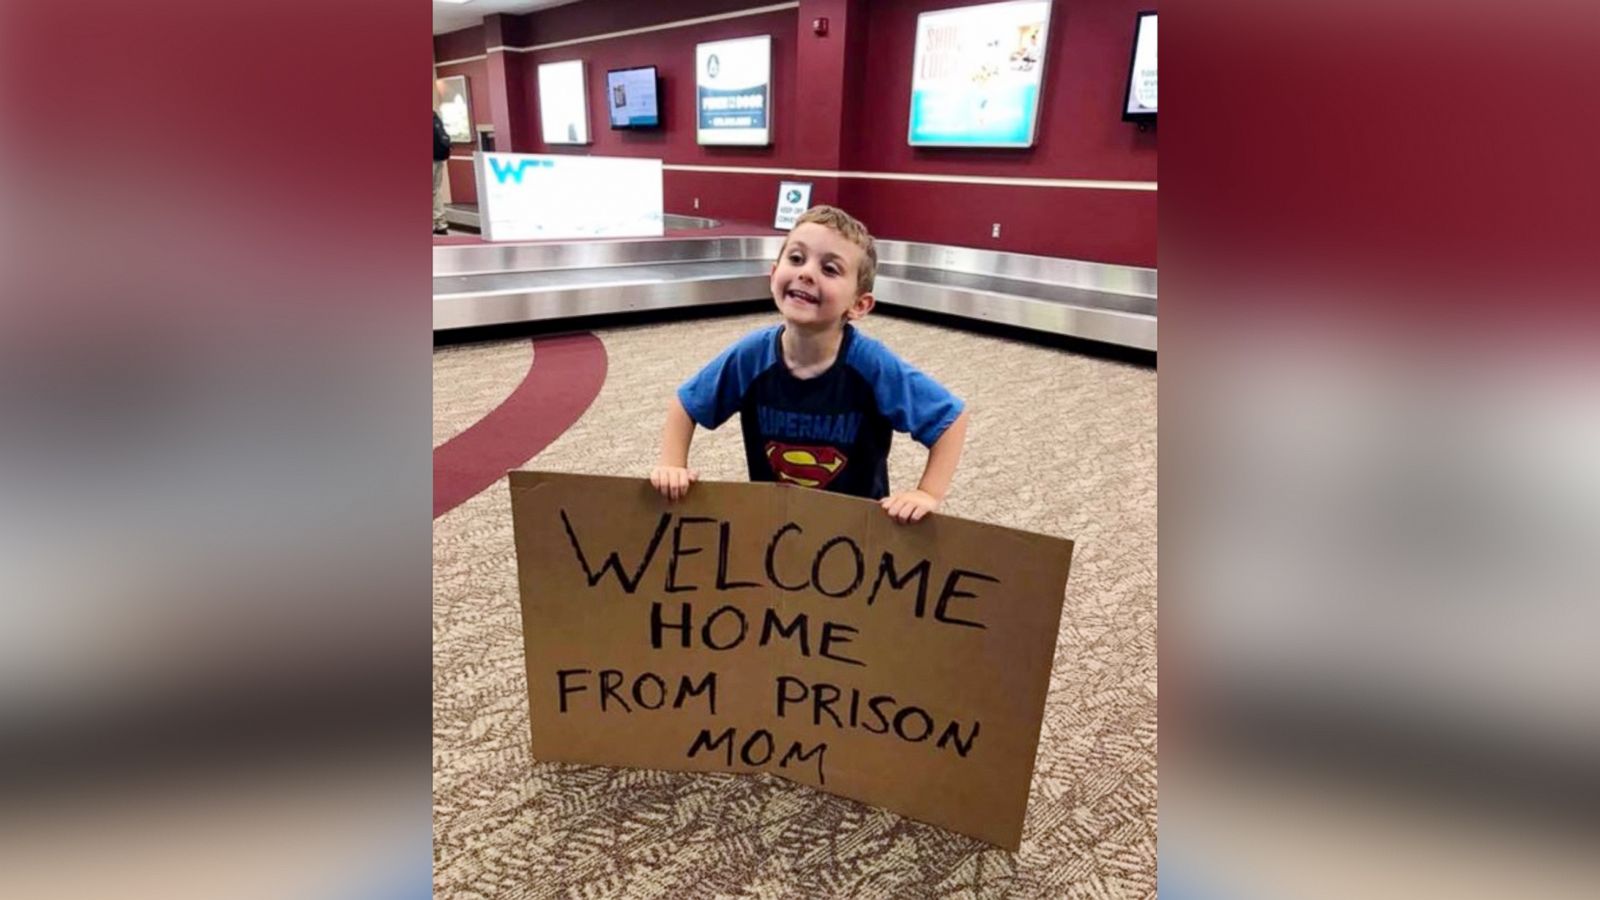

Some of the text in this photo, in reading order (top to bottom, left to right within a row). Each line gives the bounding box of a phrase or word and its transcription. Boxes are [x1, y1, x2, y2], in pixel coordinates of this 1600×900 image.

[757, 407, 863, 444] SUPERMAN
[559, 508, 1001, 630] WELCOME
[650, 602, 867, 668] HOME
[556, 669, 981, 758] FROM PRISON
[686, 727, 828, 785] MOM
